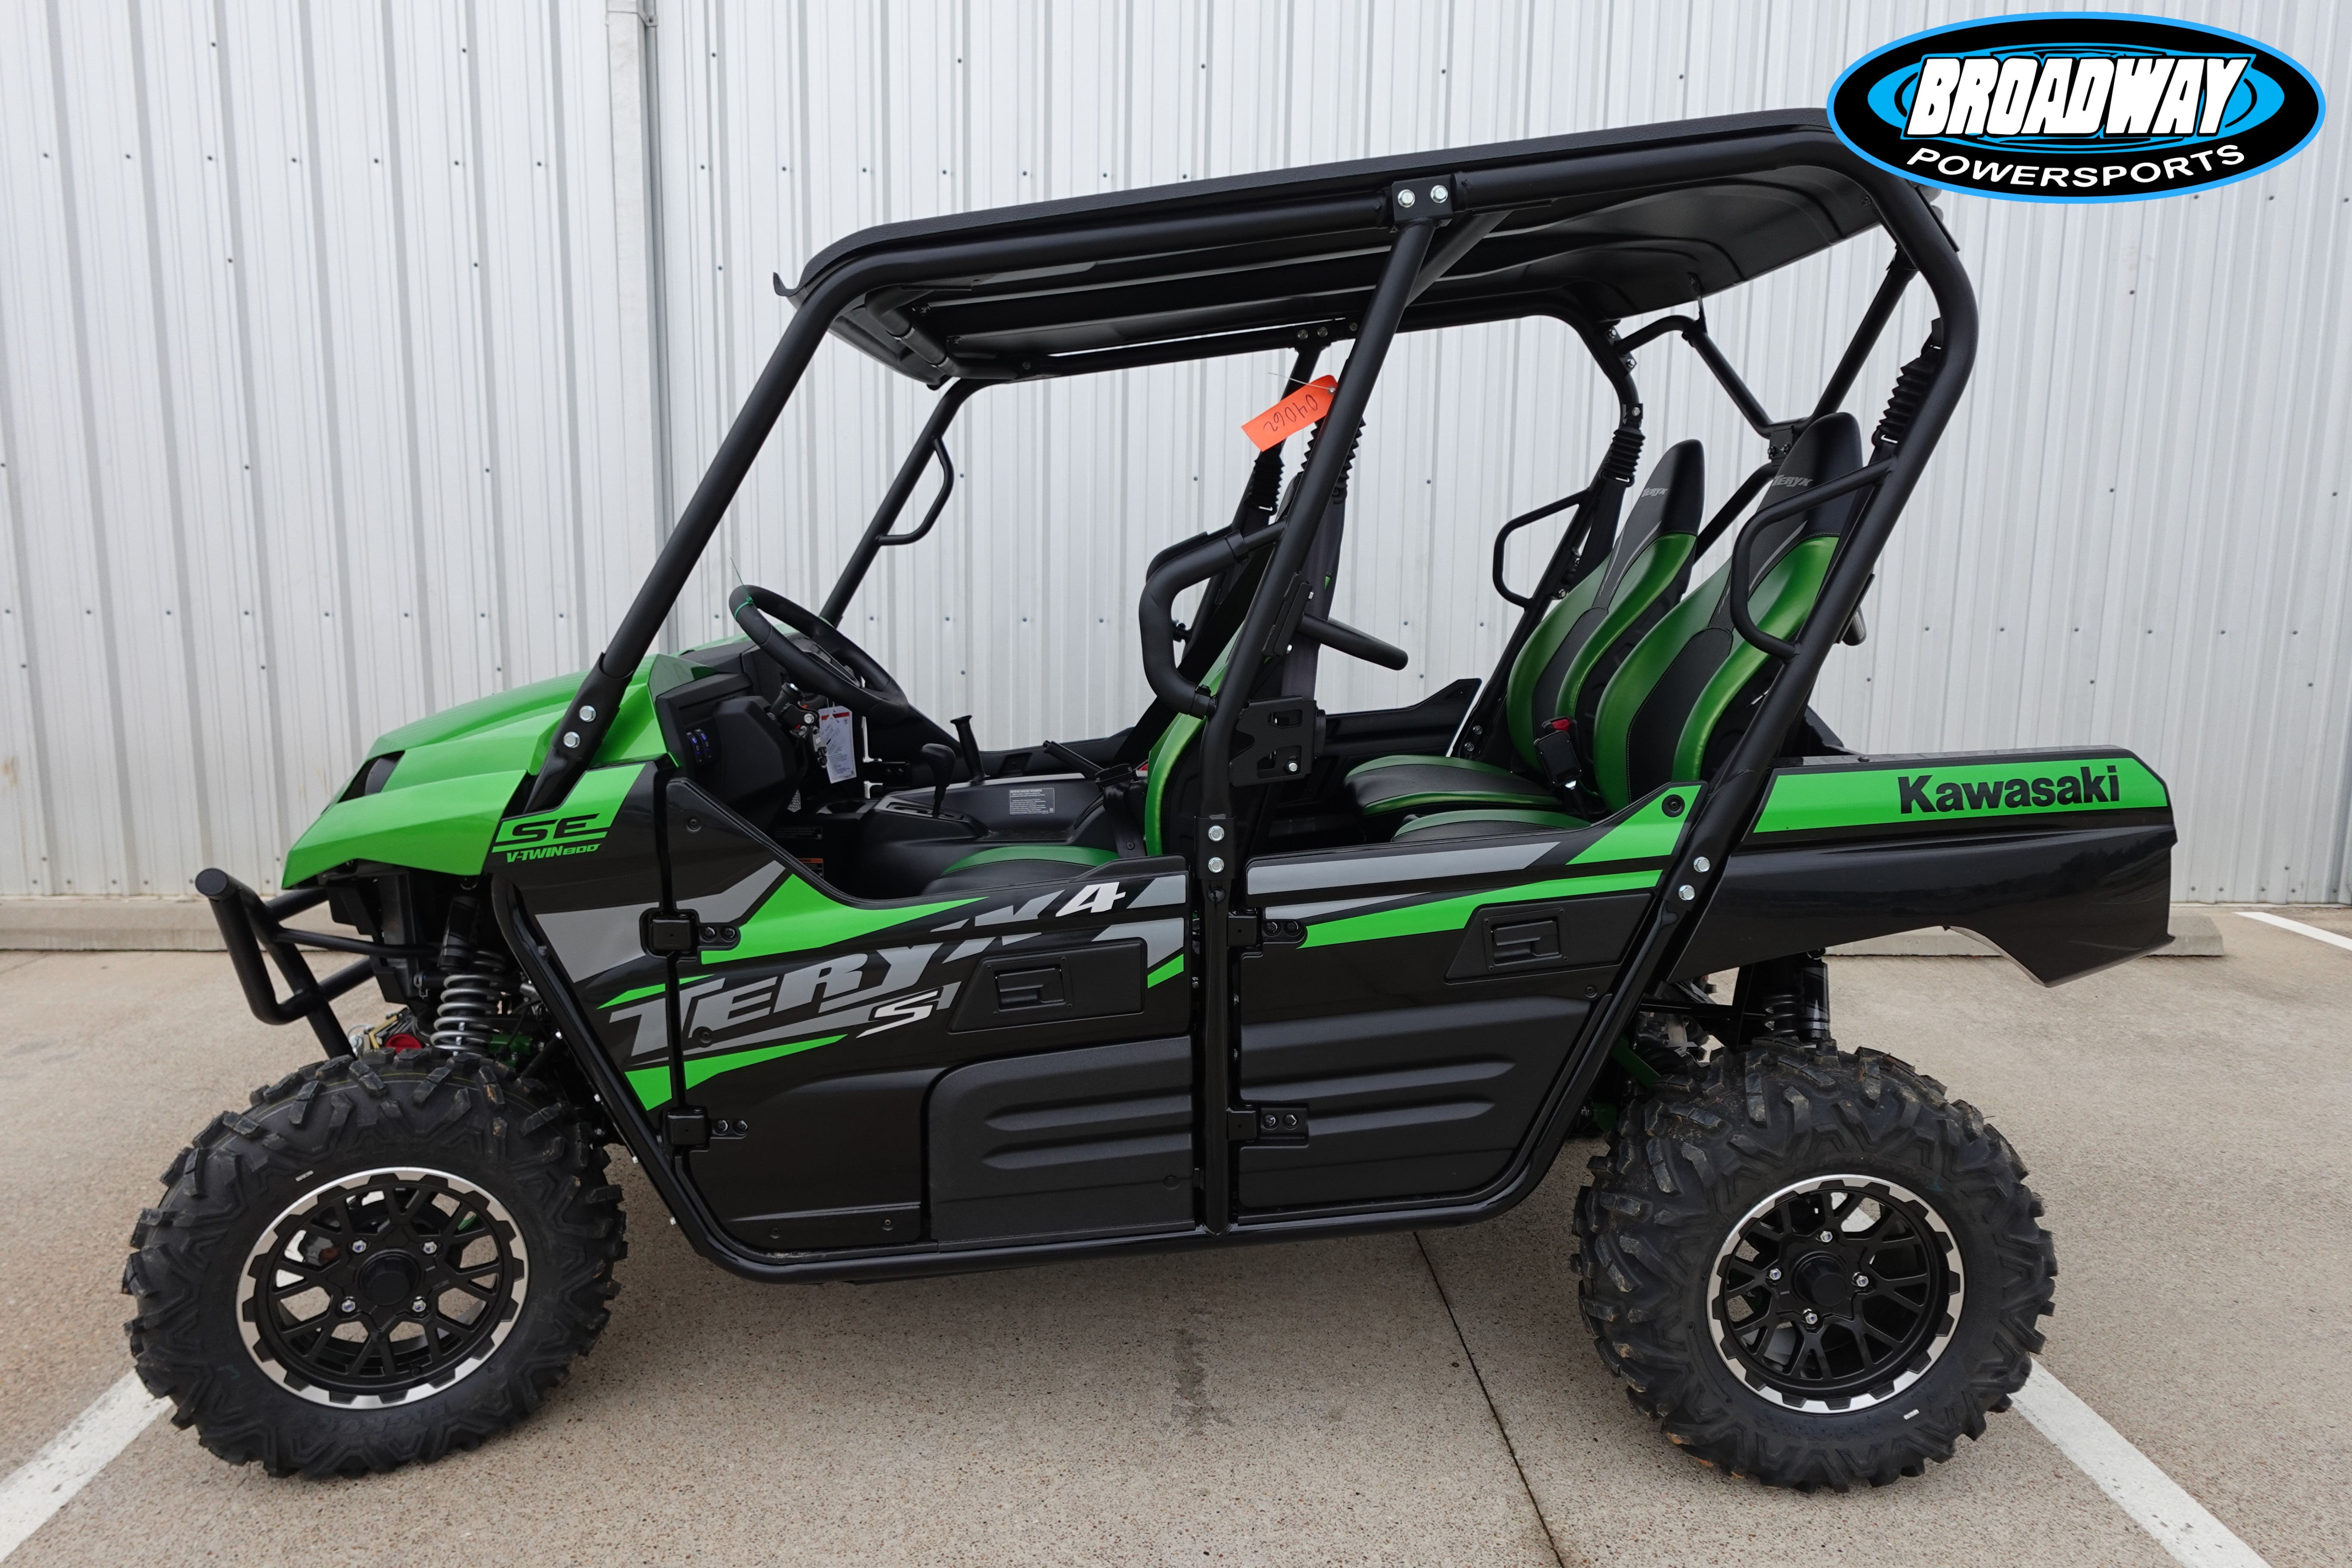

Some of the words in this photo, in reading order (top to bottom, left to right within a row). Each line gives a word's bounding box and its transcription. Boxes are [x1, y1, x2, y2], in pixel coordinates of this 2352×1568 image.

[1771, 475, 1813, 487] TERYX
[1641, 487, 1668, 498] TERYX
[1898, 765, 2120, 814] Kawasaki
[501, 813, 600, 844] SE
